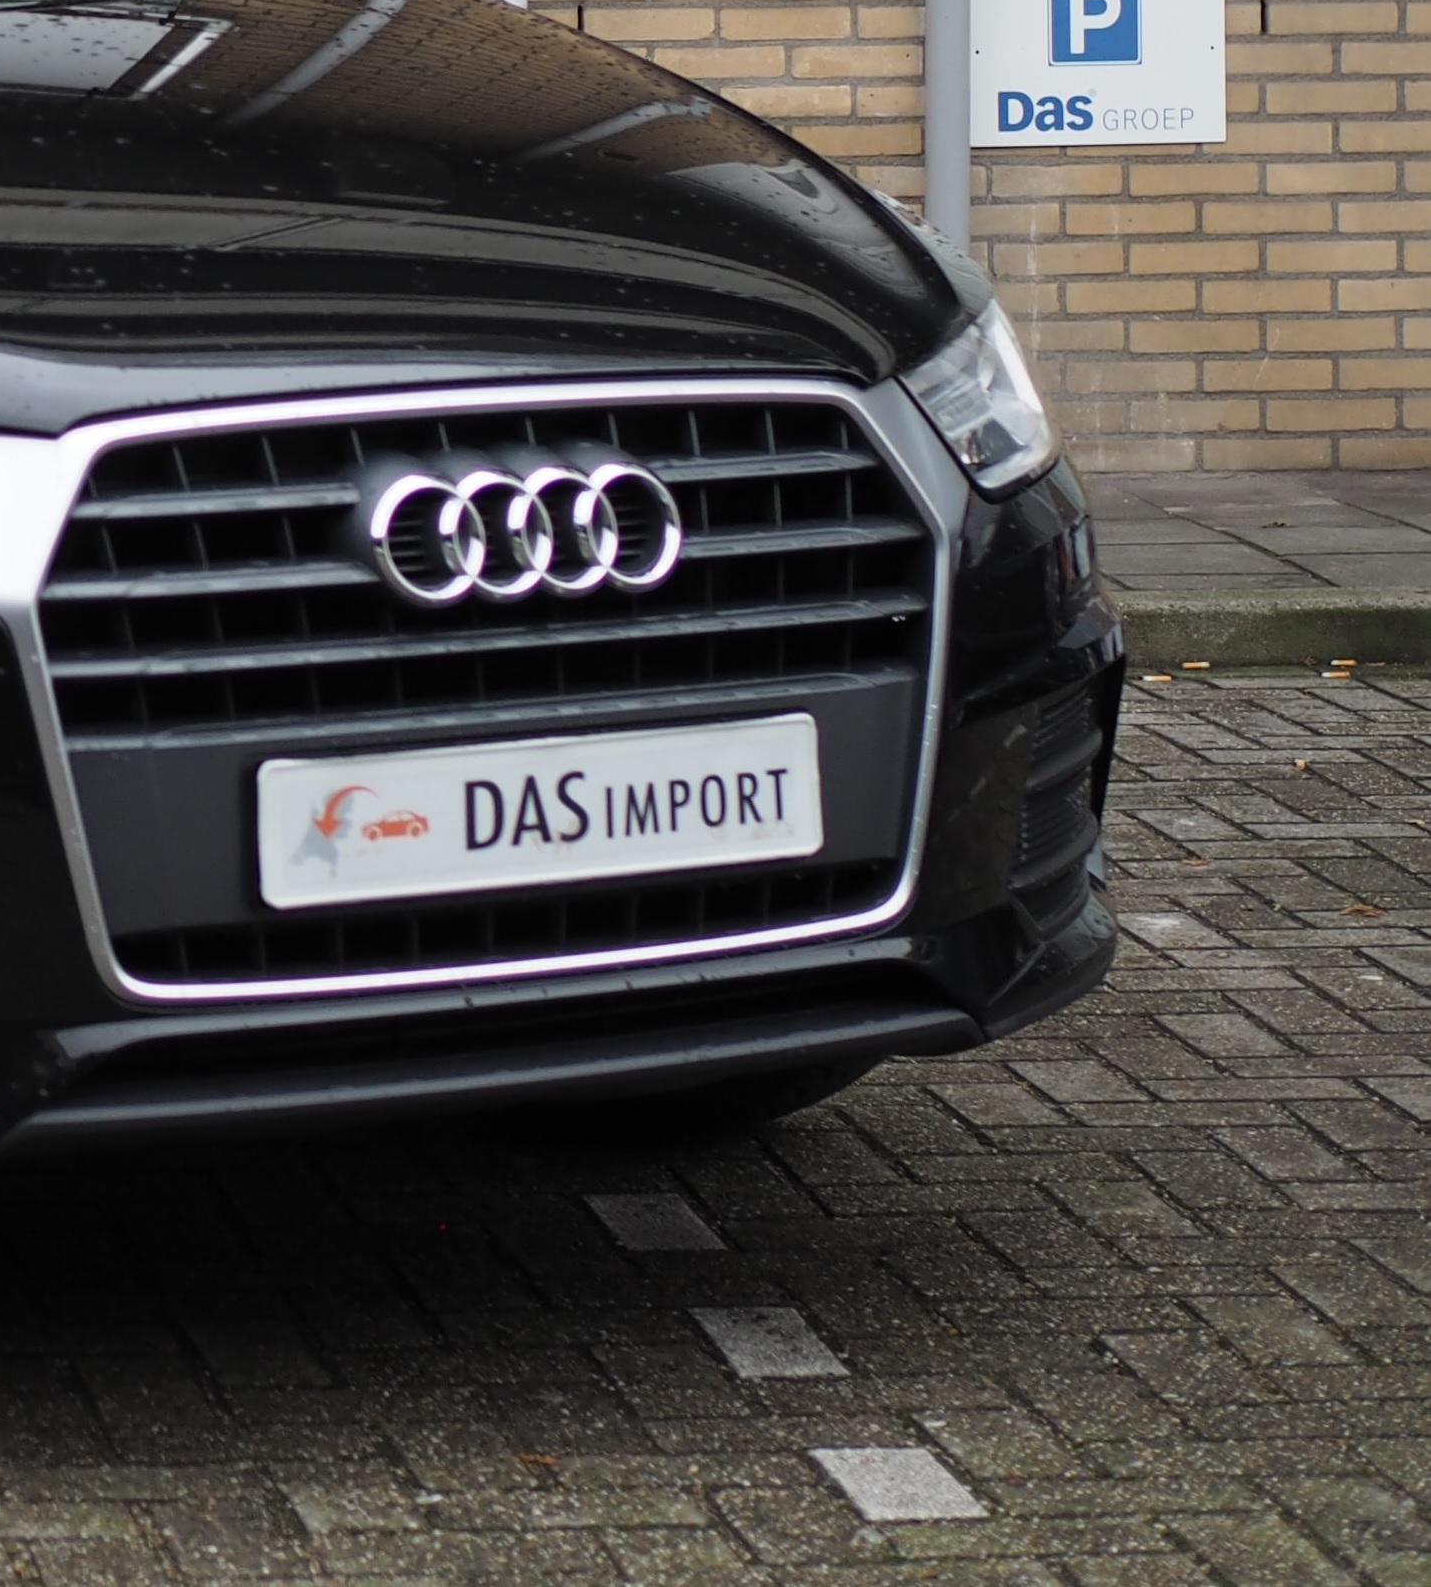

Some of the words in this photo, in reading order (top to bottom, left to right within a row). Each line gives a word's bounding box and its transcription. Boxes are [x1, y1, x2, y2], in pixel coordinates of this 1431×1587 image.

[998, 92, 1093, 132] Das
[1103, 108, 1194, 132] GROEP
[465, 772, 590, 850] DAS
[606, 768, 789, 840] IMPORT
